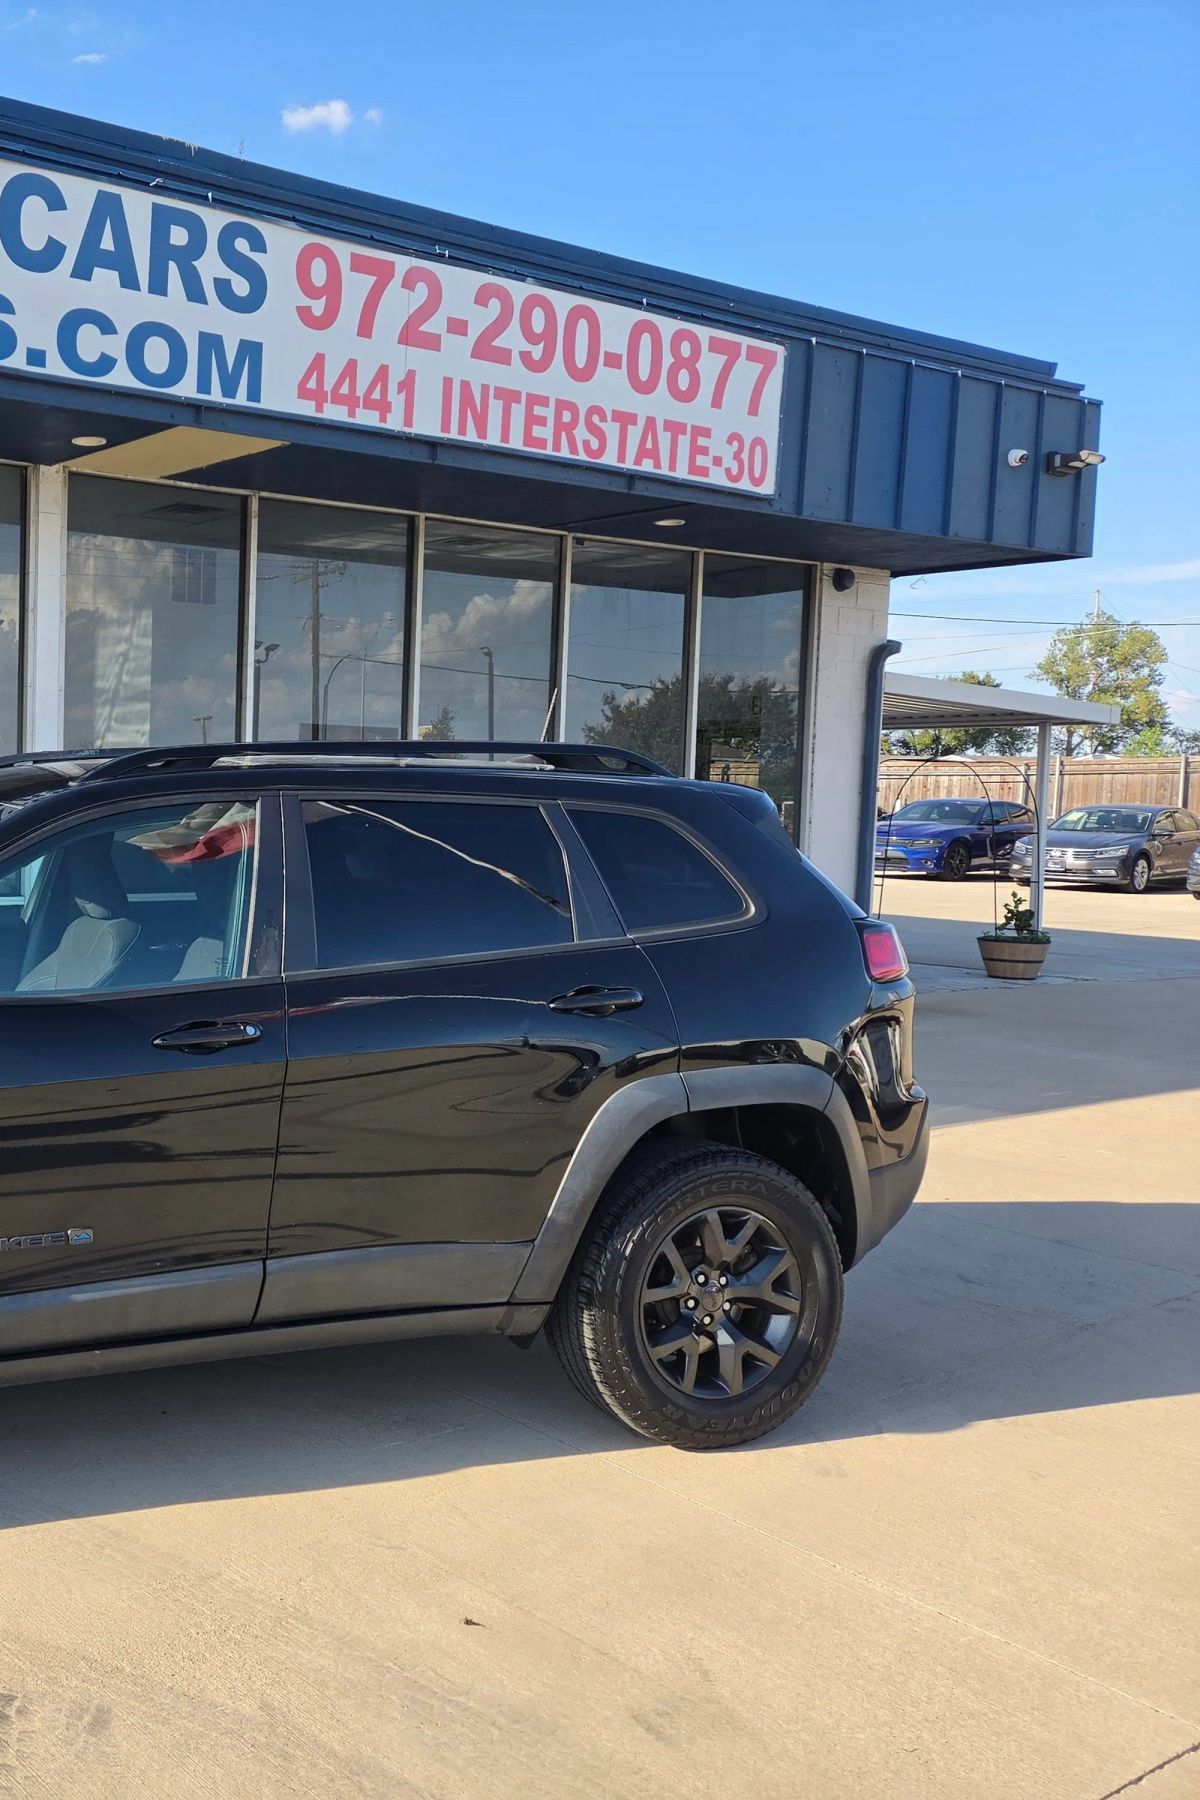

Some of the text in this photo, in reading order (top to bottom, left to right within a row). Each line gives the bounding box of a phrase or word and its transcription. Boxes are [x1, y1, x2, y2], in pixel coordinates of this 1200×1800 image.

[294, 242, 778, 418] 972-290-0877
[297, 352, 769, 488] 4441 INTERSTATE-30
